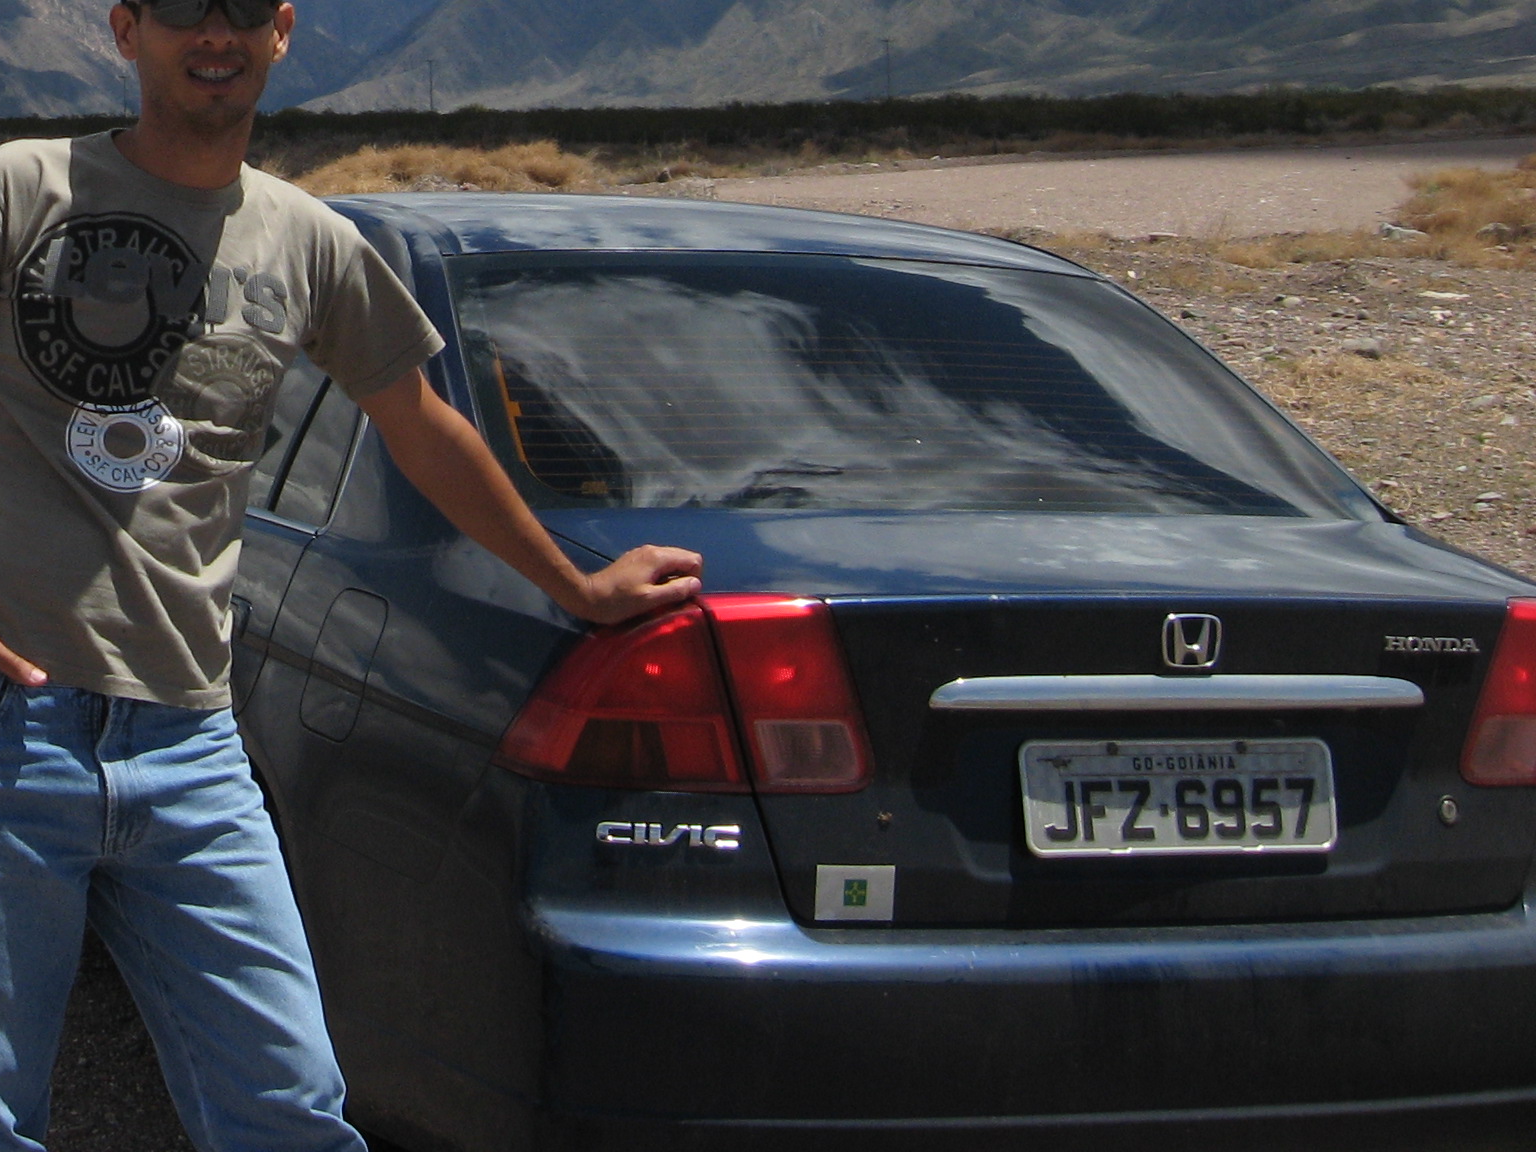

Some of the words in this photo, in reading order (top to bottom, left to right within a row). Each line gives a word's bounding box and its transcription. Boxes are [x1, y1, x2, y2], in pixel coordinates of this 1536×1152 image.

[86, 362, 146, 397] CAL
[111, 467, 145, 483] CAL
[1385, 635, 1480, 652] HONDA
[596, 821, 741, 849] CIVIC
